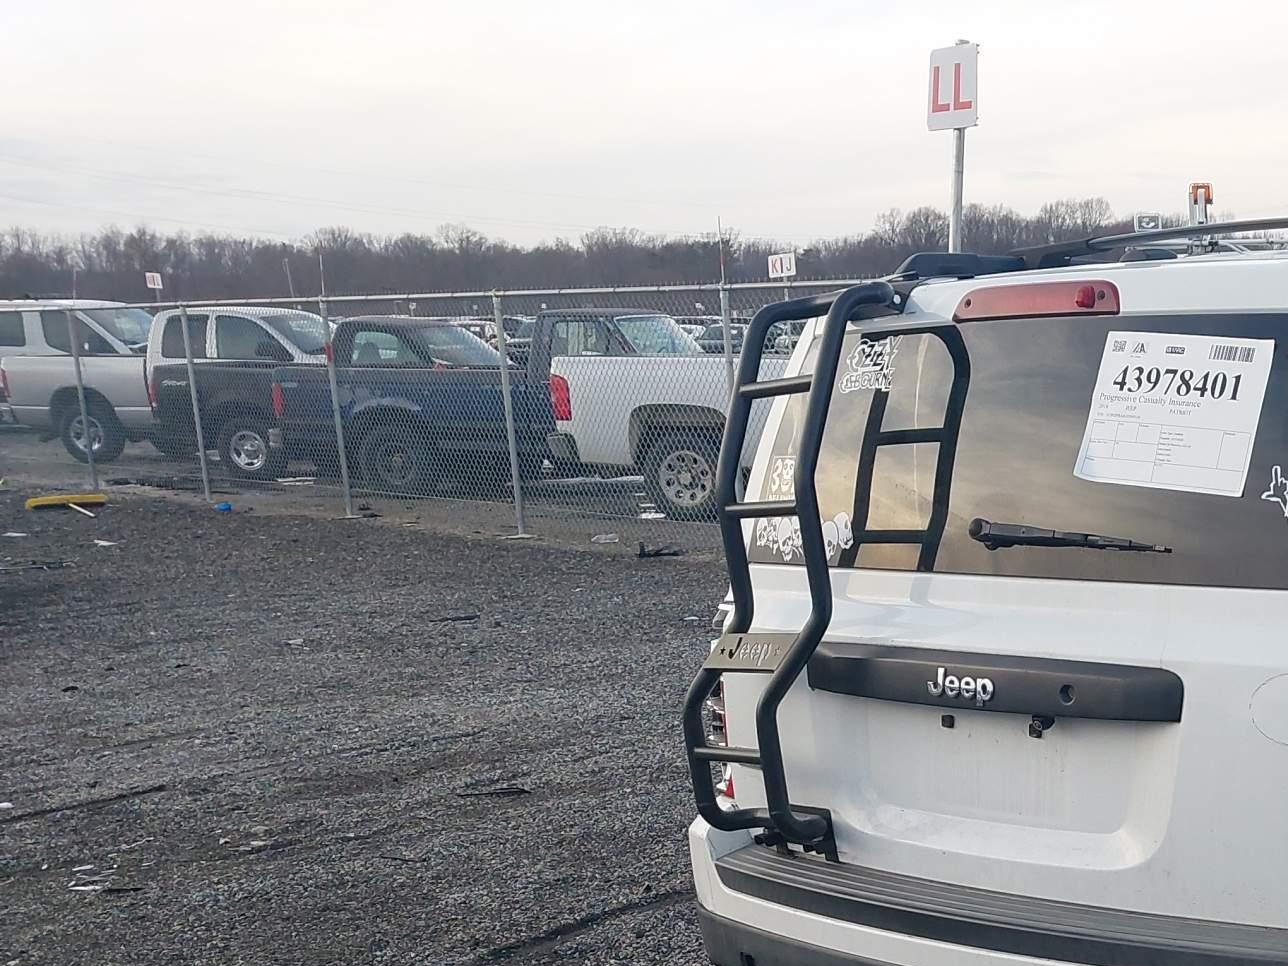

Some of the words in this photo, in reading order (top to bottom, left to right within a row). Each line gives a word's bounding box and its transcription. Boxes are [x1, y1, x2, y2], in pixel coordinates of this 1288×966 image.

[932, 62, 972, 113] LL
[847, 336, 903, 372] OZZY
[1099, 391, 1138, 404] Progressive
[1138, 395, 1167, 406] Casualty
[1168, 398, 1202, 408] Insurance
[1112, 364, 1242, 401] 43978401
[728, 637, 772, 667] Jeep
[927, 667, 994, 707] Jeep
